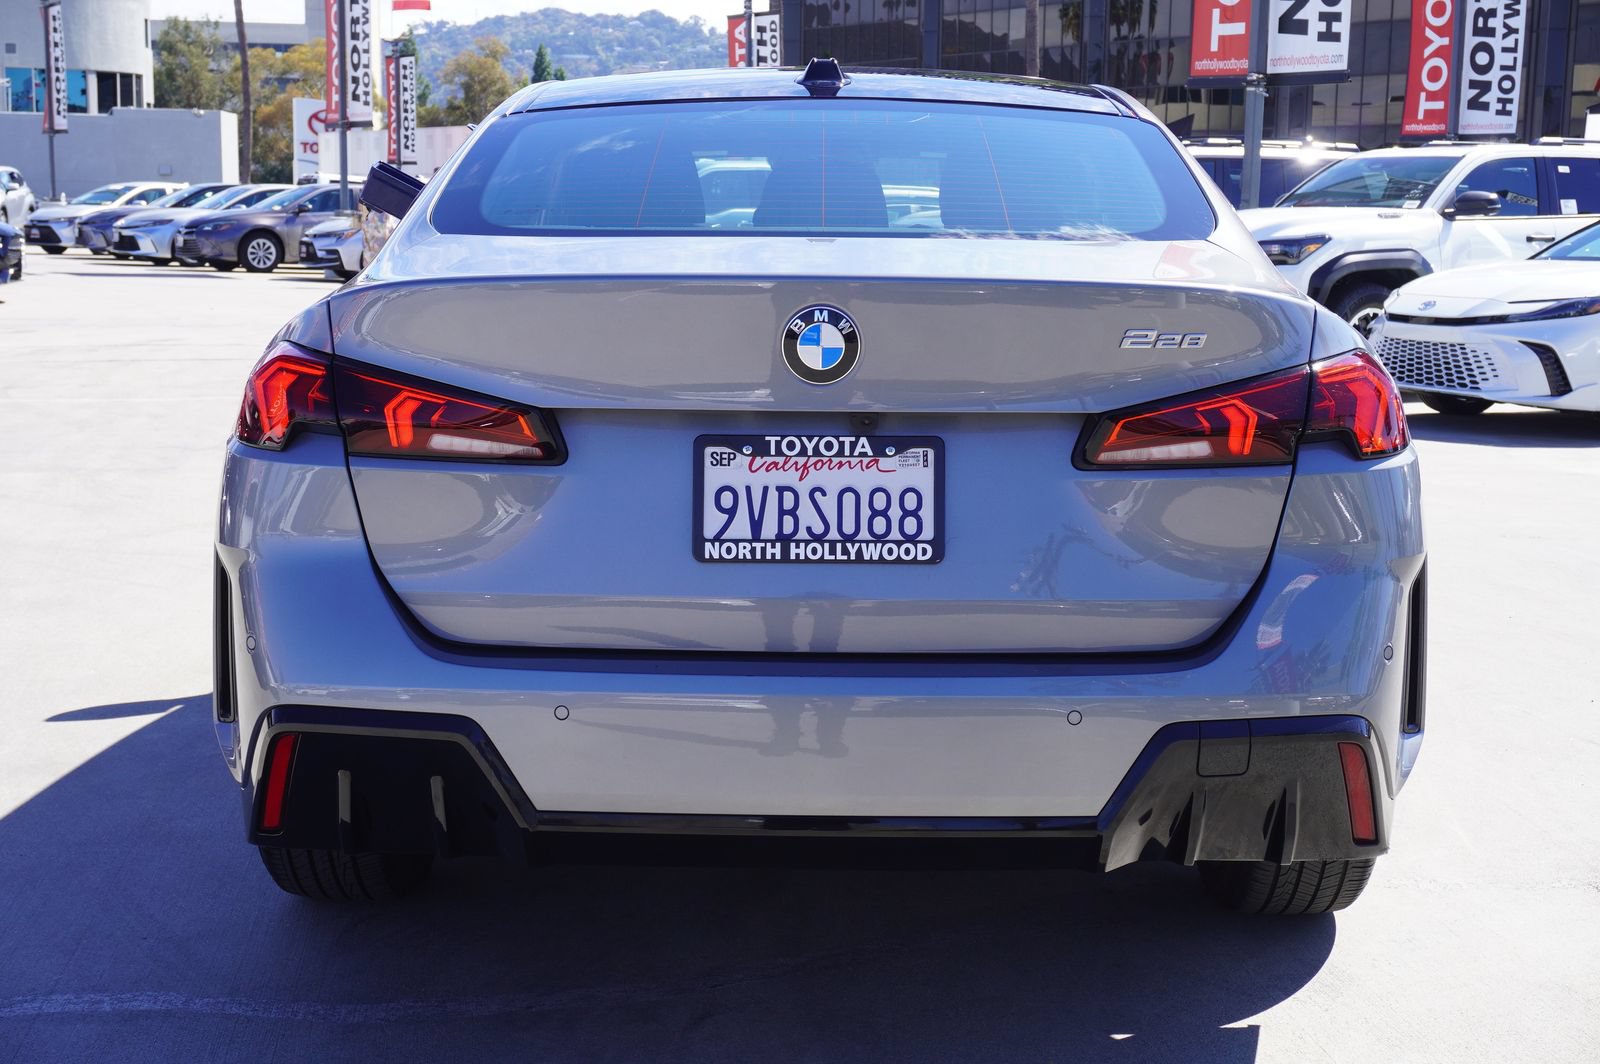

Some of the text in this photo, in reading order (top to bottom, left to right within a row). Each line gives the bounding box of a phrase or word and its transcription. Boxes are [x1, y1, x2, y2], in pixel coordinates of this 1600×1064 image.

[1210, 0, 1246, 52] T
[1317, 0, 1342, 43] H
[331, 0, 339, 110] TOYO
[361, 0, 370, 106] HOLLYW
[756, 25, 768, 67] TH
[1417, 0, 1452, 120] TOYO
[1467, 0, 1499, 112] NOR
[402, 63, 410, 150] NORTH
[408, 60, 416, 153] HOLLYWOOD
[789, 309, 854, 335] BMW
[1119, 328, 1208, 349] 228
[710, 450, 737, 467] SEP
[748, 456, 897, 481] California
[765, 436, 874, 456] TOYOTA
[713, 485, 924, 541] 9VBS088
[704, 542, 933, 561] NORTH HOLLYWOOD
